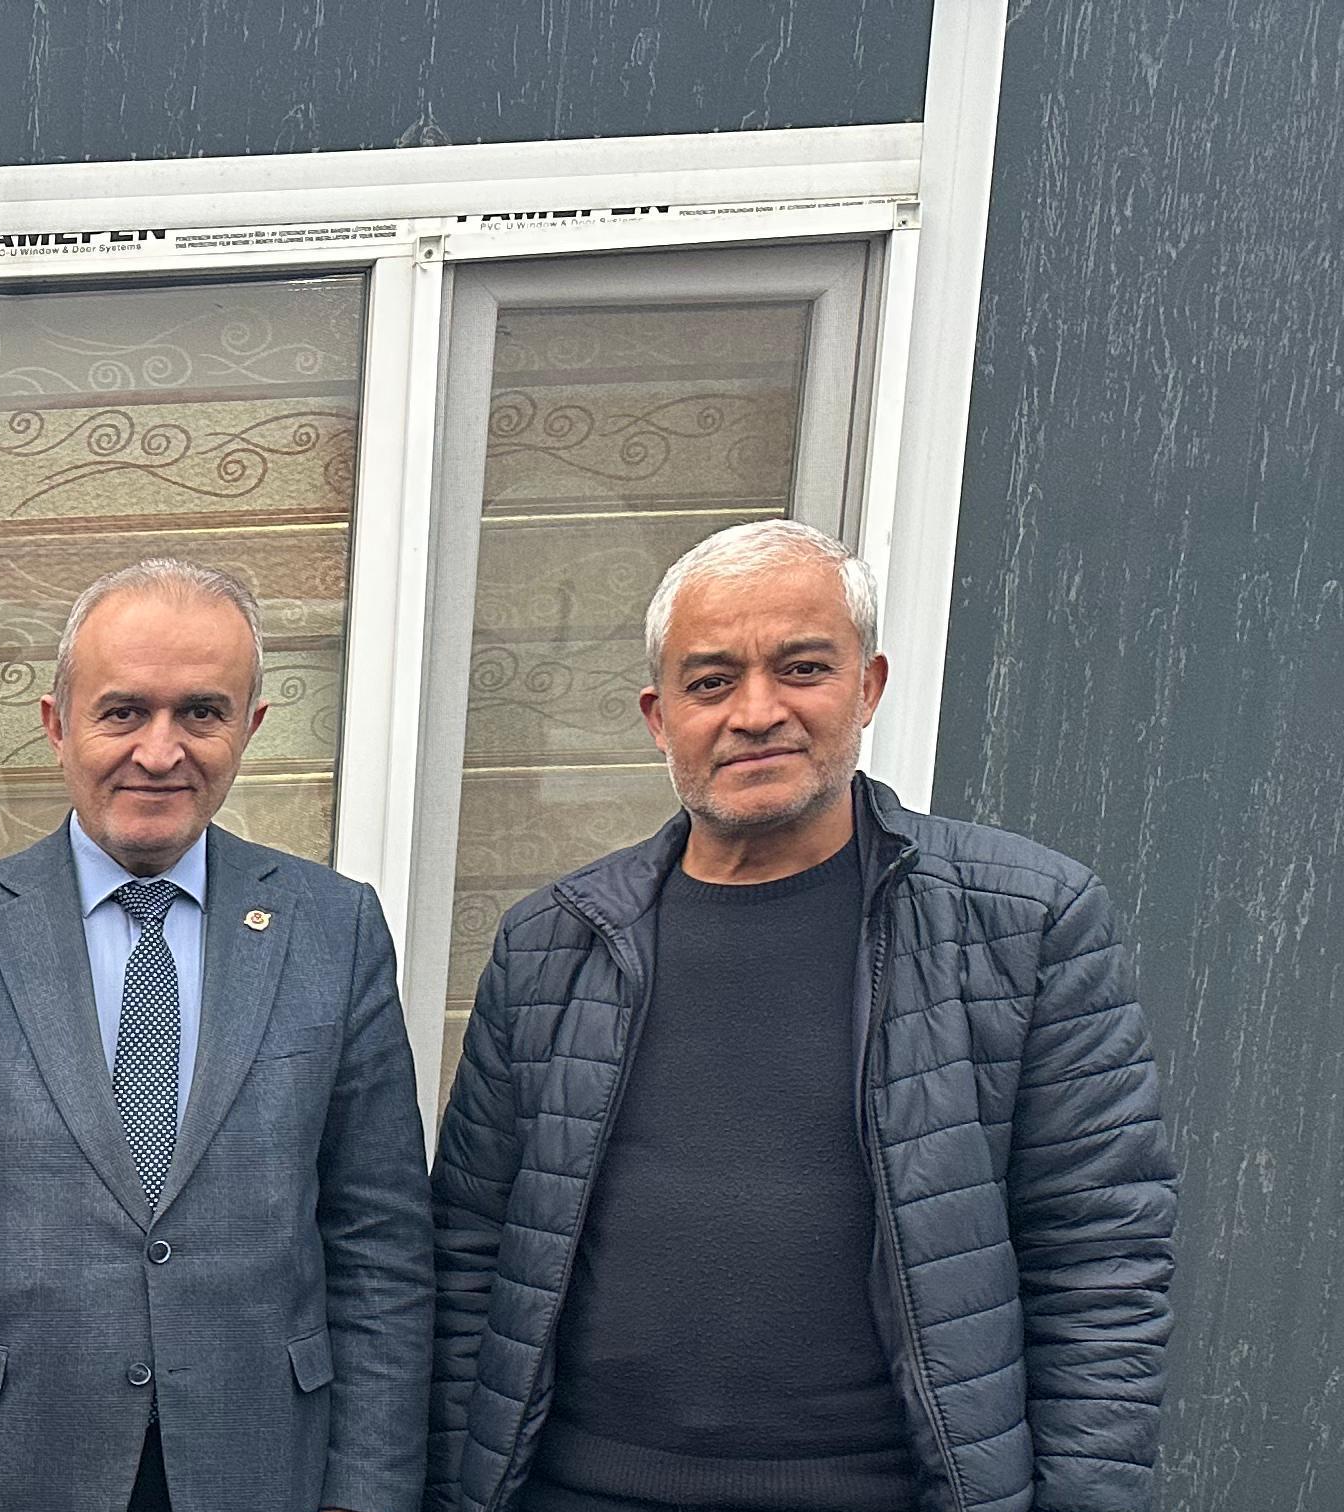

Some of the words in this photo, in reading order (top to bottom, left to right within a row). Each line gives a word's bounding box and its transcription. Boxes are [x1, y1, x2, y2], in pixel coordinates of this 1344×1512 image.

[20, 246, 59, 256] Window
[62, 245, 69, 254] &
[72, 244, 96, 253] Door
[98, 242, 142, 252] Systems
